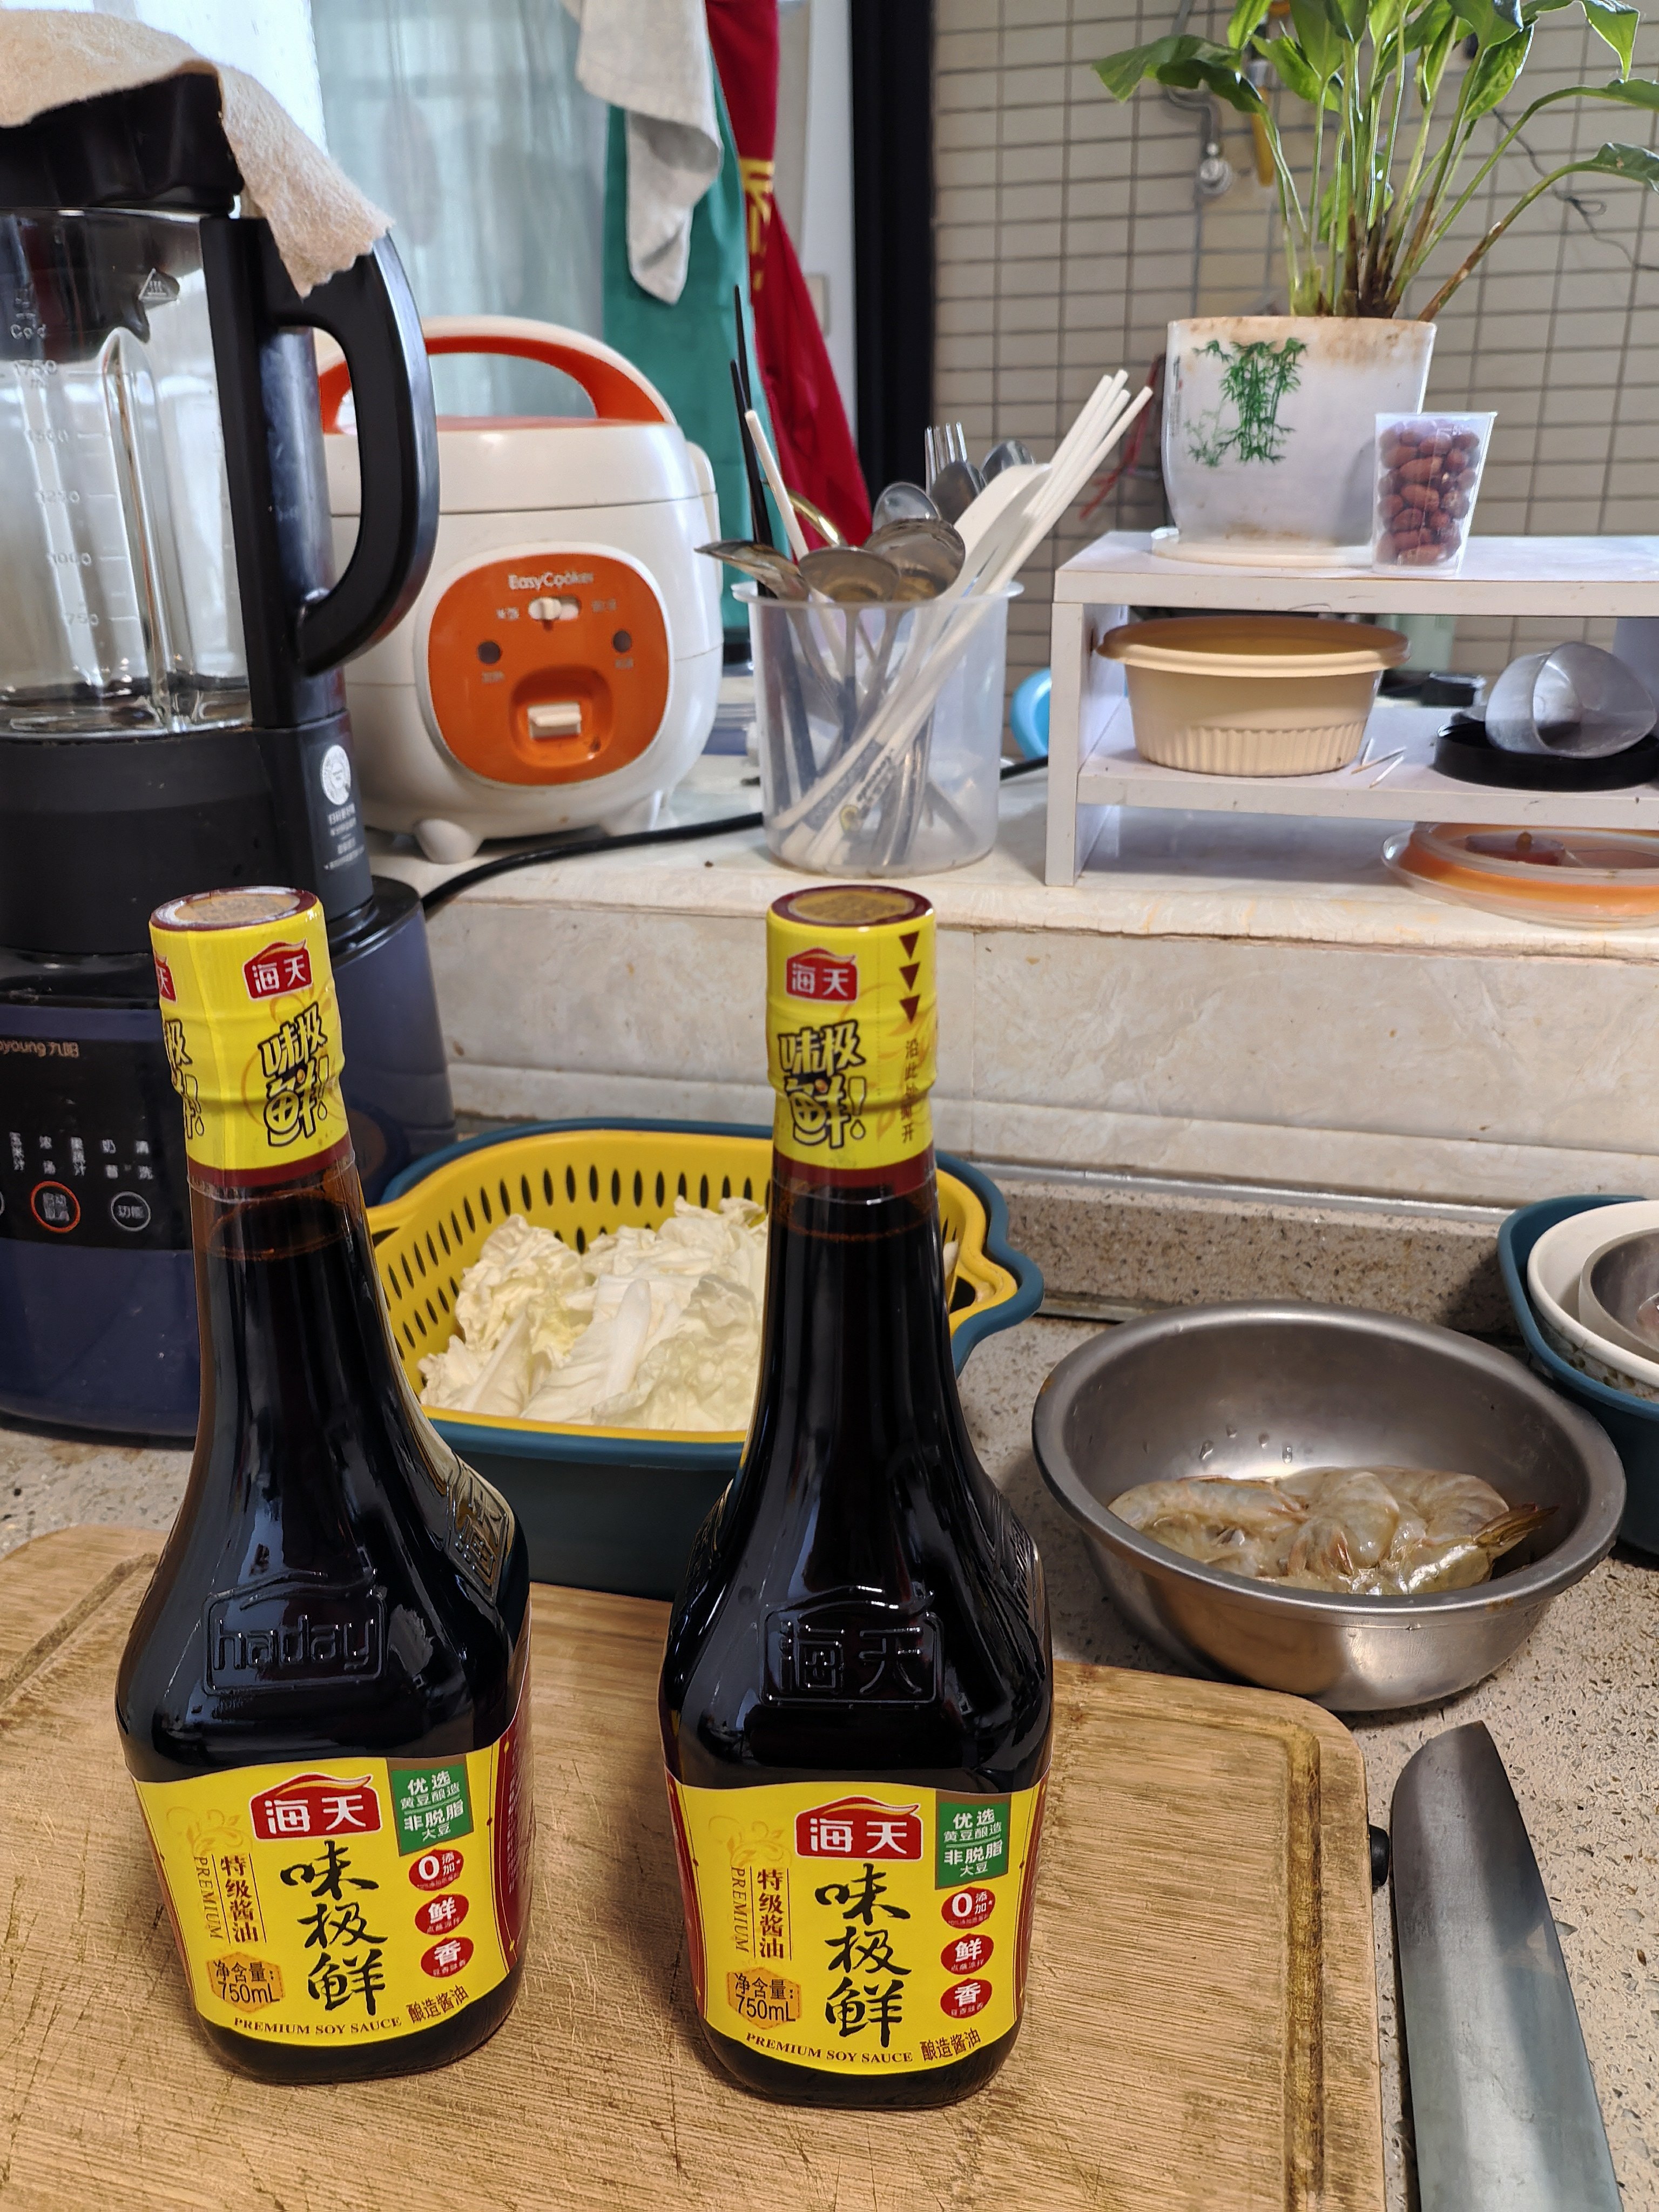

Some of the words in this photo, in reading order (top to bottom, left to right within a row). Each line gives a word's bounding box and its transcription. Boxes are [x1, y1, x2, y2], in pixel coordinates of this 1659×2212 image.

[252, 954, 307, 993] 海天
[791, 962, 849, 997] 海天
[400, 1782, 460, 1809] 黄豆酿造
[408, 1770, 451, 1796] 优选
[265, 1794, 367, 1835] 海天
[404, 1799, 464, 1831] 非脱脂
[953, 1808, 995, 1830] 优选
[422, 1822, 451, 1842] 大豆
[810, 1818, 908, 1854] 海天
[943, 1821, 1002, 1843] 黄豆酿造
[944, 1839, 1003, 1865] 非脱脂
[959, 1860, 989, 1877] 大豆
[193, 1856, 223, 1940] PREMIUM
[220, 1854, 259, 1943] 特级酱油
[428, 1897, 457, 1924] 鲜
[730, 1866, 750, 1953] PREMIUM
[280, 1839, 389, 2017] 味极鲜
[757, 1869, 784, 1959] 特级酱油
[434, 1939, 461, 1967] 香
[814, 1863, 913, 2048] 味极鲜
[955, 1937, 982, 1963] 鲜
[218, 1980, 281, 2004] 750mL
[406, 1984, 470, 2025] 酿造酱油
[954, 1982, 982, 2007] 香
[736, 1996, 797, 2022] 750mL
[234, 2017, 310, 2035] PREMIUM
[315, 2023, 346, 2035] SOY
[350, 2015, 402, 2034] SAUCE
[745, 2031, 821, 2058] PREMIUM
[826, 2050, 858, 2062] SOY
[861, 2051, 913, 2063] SAUCE
[919, 2028, 982, 2062] 酿造酱油
